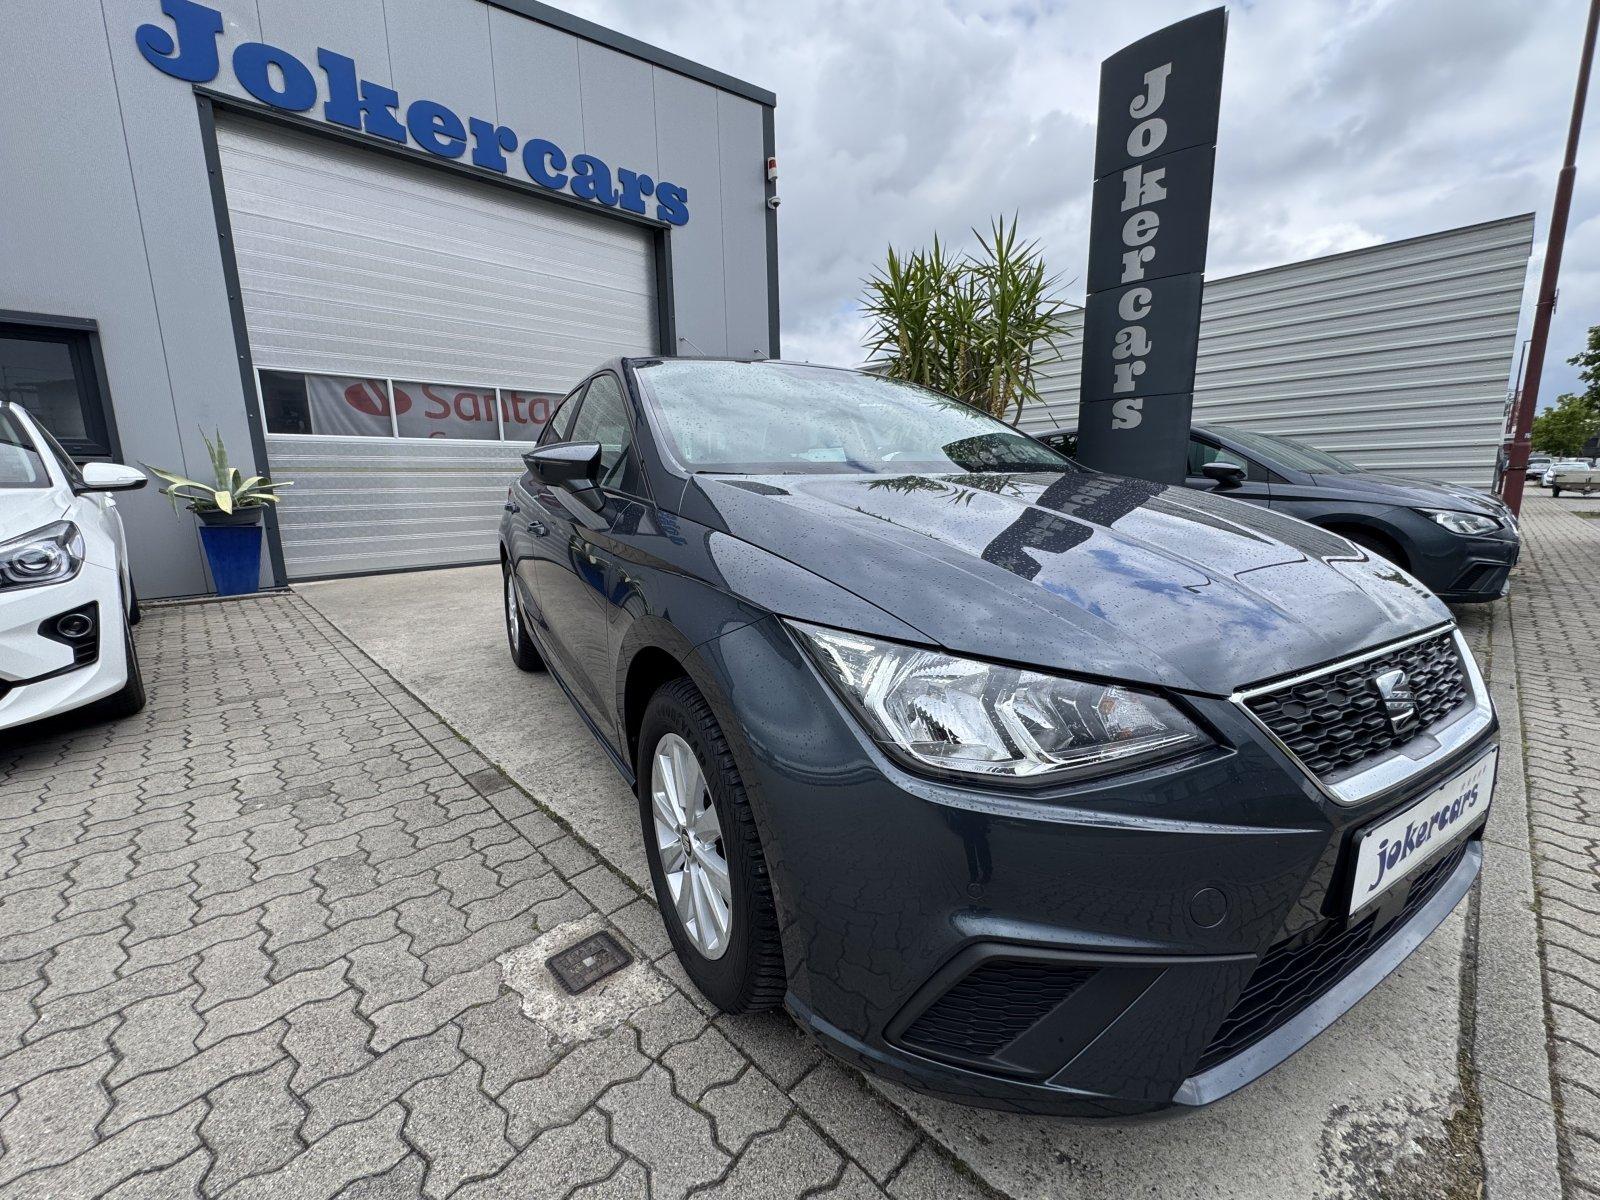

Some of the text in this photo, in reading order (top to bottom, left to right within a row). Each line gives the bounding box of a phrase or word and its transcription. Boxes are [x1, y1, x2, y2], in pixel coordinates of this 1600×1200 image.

[136, 0, 690, 226] Jokercars
[1112, 62, 1173, 430] Jokercars
[421, 384, 563, 425] Santa
[1368, 783, 1479, 892] jokercars
